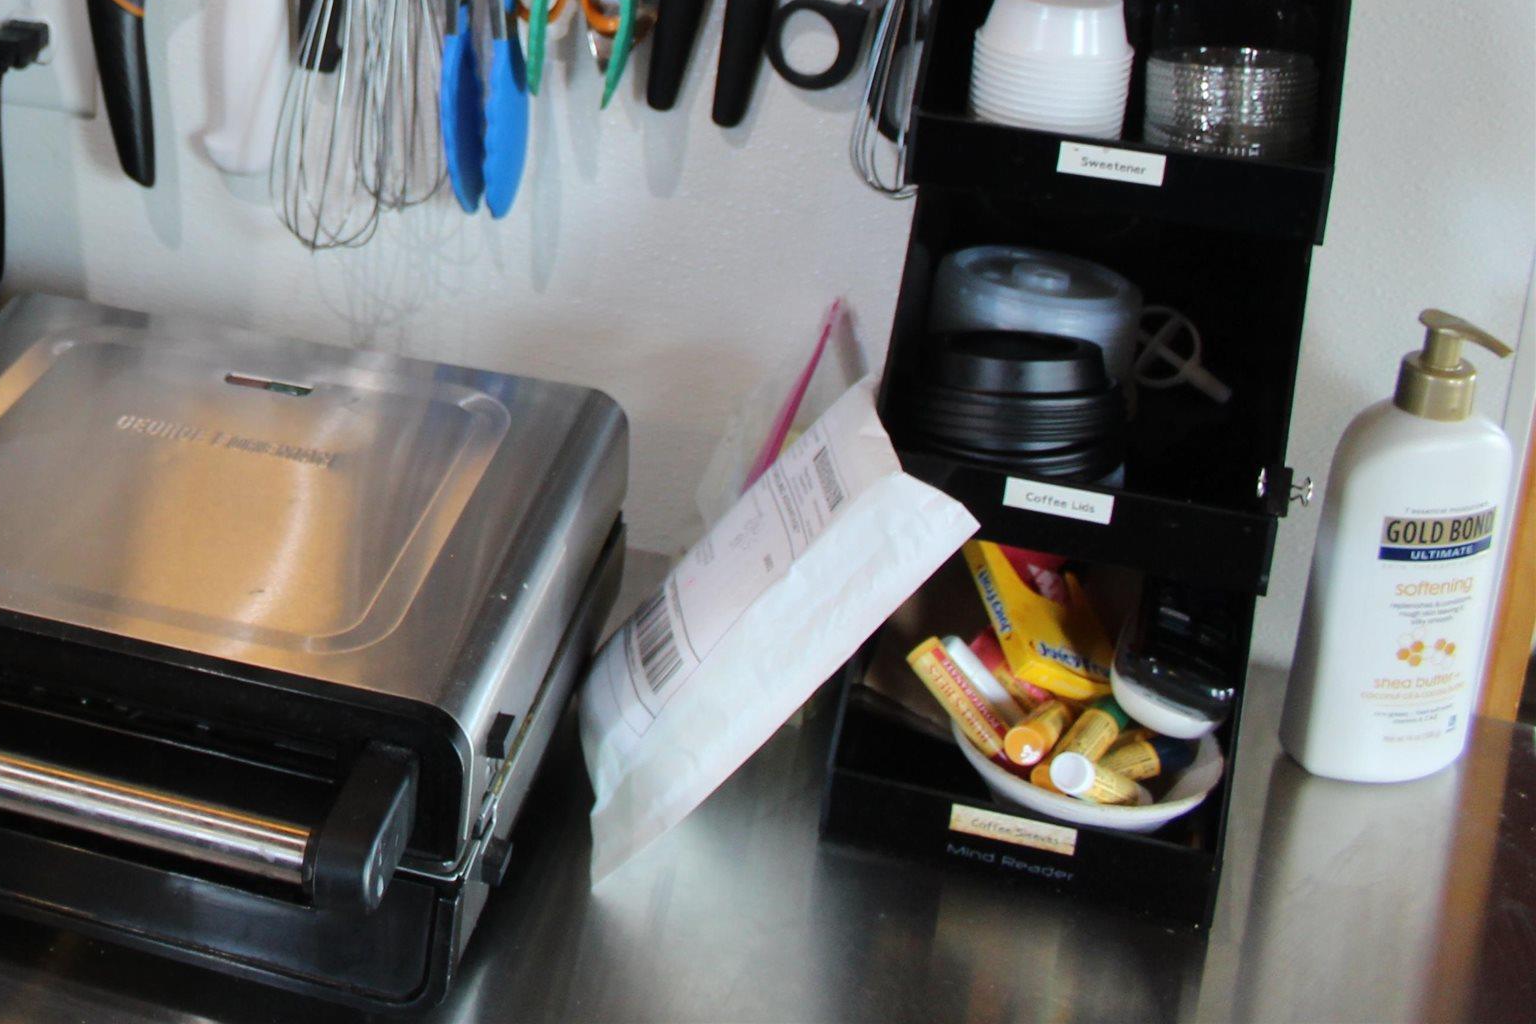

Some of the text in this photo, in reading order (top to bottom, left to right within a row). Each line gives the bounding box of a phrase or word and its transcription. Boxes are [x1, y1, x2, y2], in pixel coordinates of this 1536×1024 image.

[1081, 156, 1147, 175] Sweetener
[1025, 491, 1096, 514] Coffee Lids
[1387, 519, 1444, 544] GOLD
[1410, 545, 1473, 560] ULTIMATE
[1395, 576, 1473, 596] softening
[970, 818, 1010, 834] Coffee
[946, 842, 1075, 881] Mind Reader
